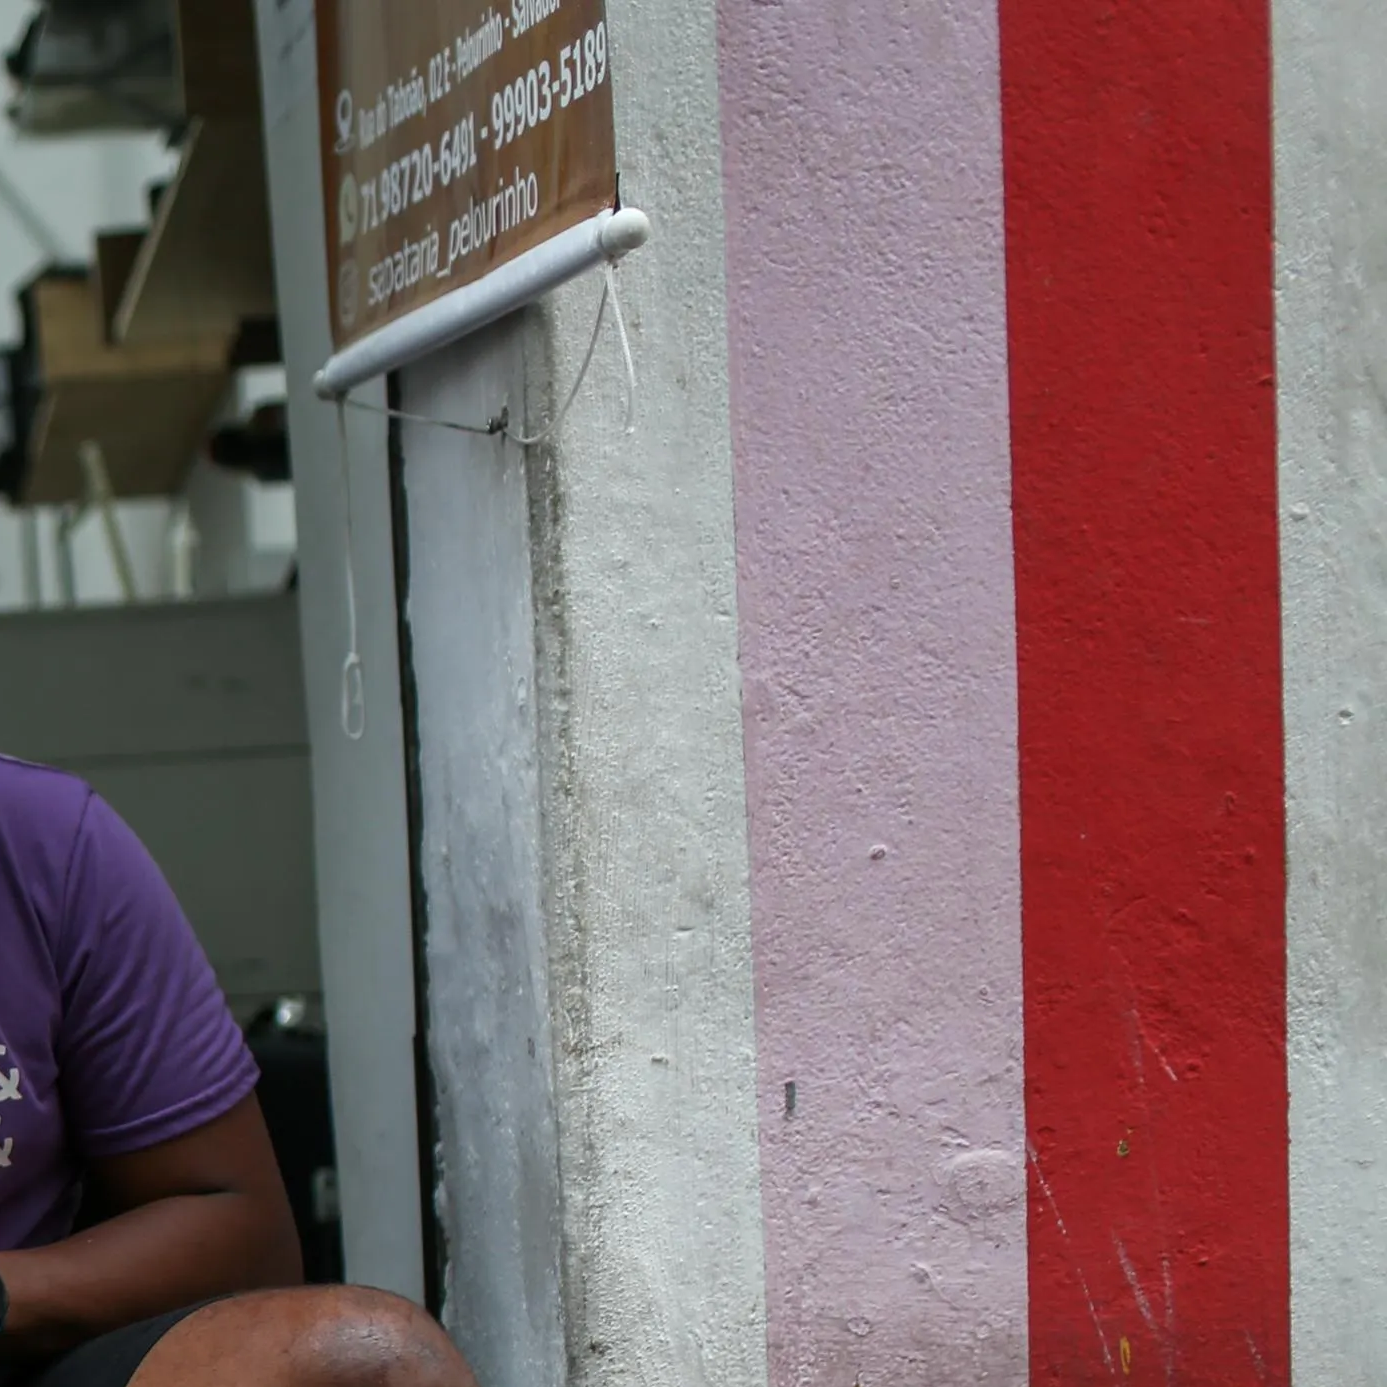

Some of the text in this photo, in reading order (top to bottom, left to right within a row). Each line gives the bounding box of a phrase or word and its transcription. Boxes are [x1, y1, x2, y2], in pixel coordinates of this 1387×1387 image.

[456, 5, 503, 85] Pelourinho
[492, 20, 607, 151] 99903-5189
[367, 165, 538, 305] sapataria_pelourinho
